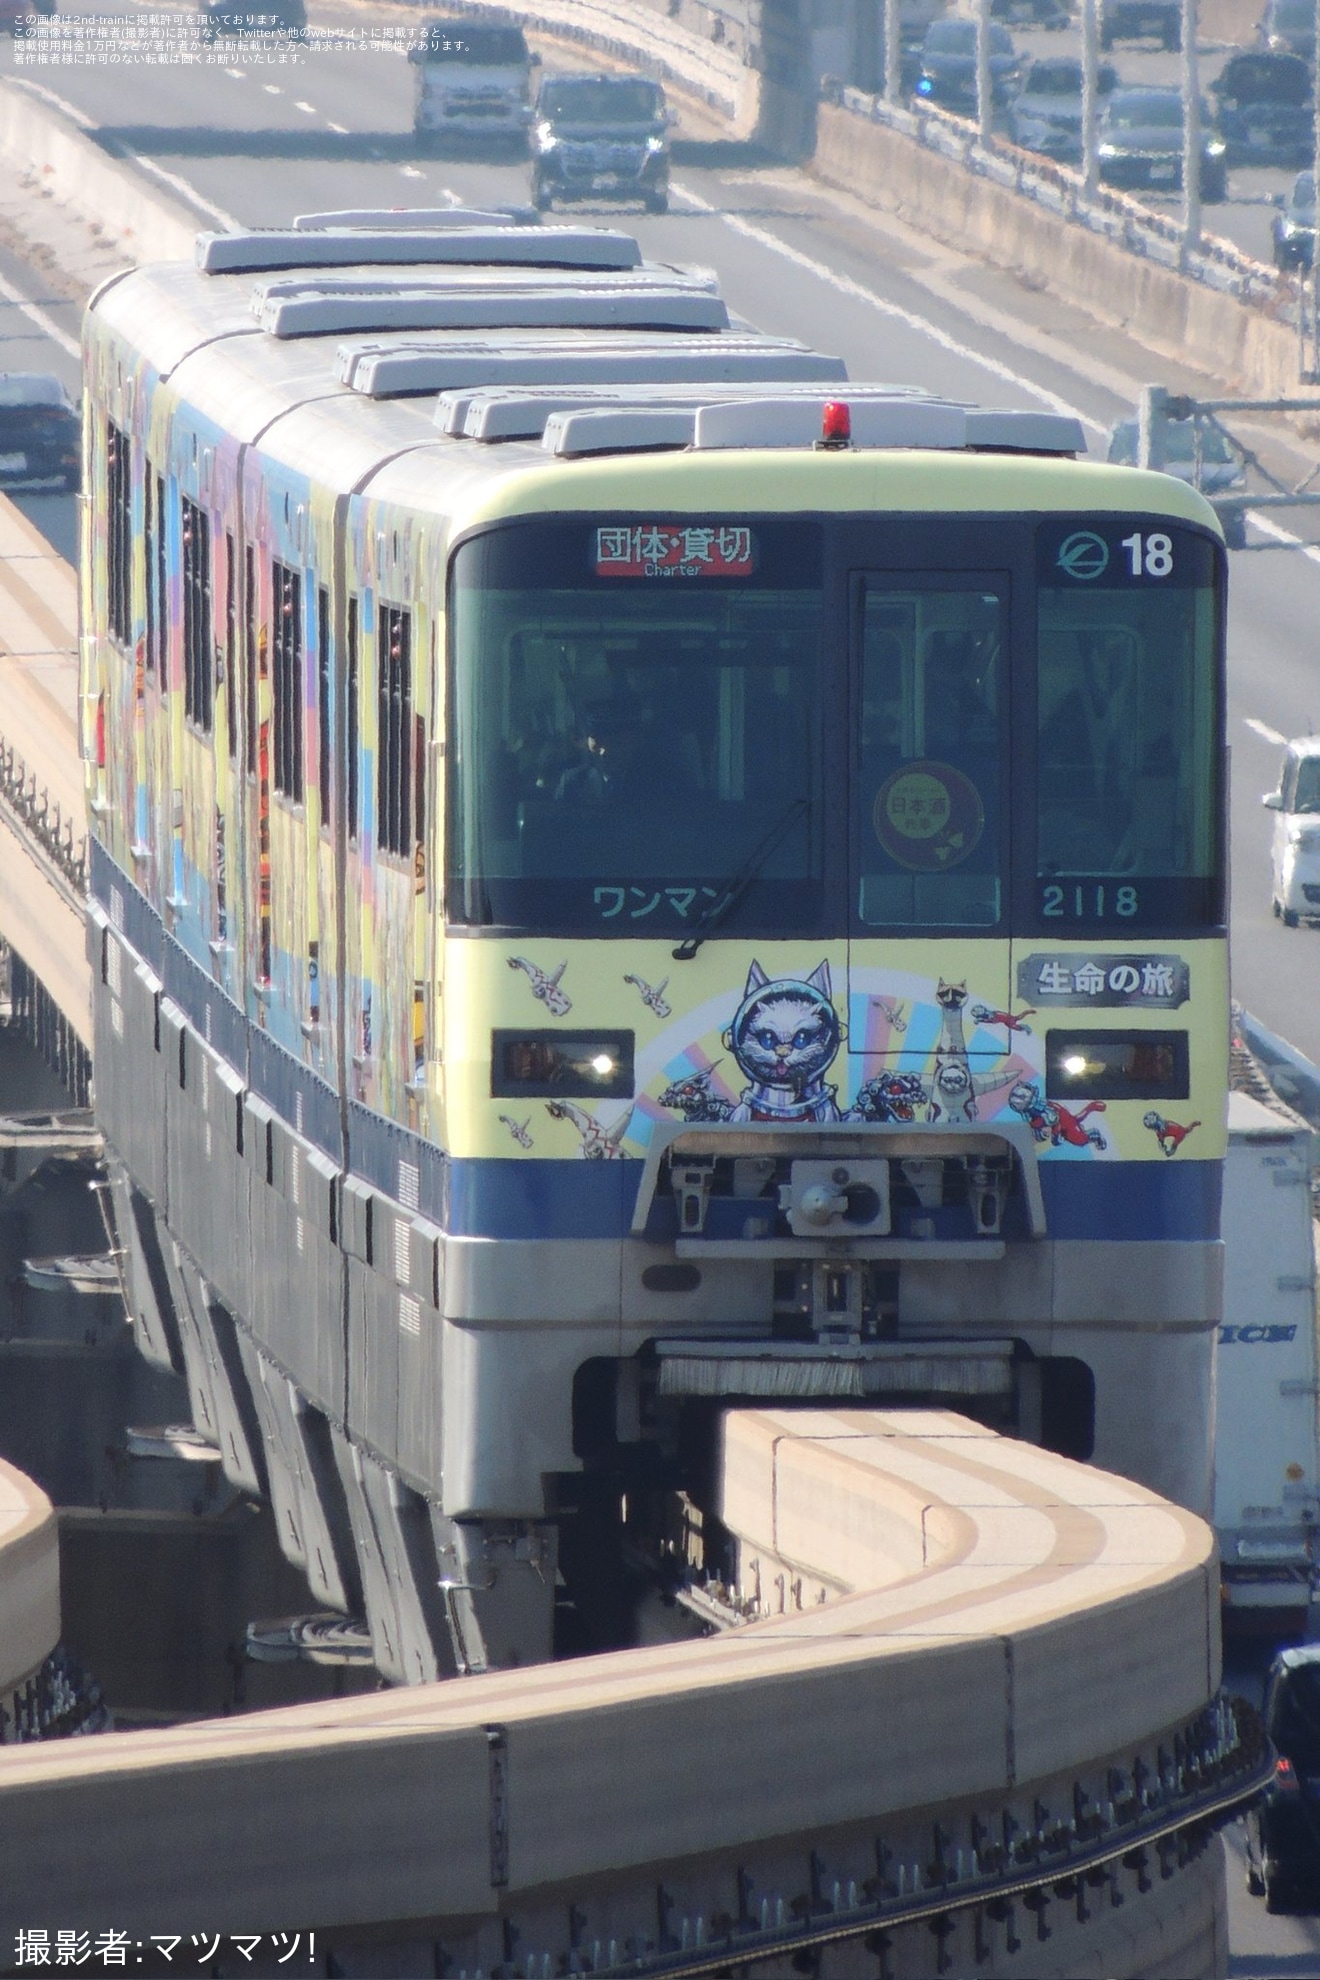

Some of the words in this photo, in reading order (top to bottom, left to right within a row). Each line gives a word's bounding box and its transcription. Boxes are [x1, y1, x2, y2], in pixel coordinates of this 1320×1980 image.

[644, 563, 703, 578] Charter
[1121, 532, 1174, 576] 18
[593, 886, 733, 918] ワンマン
[1042, 884, 1139, 917] 2118
[1036, 961, 1175, 997] 生命の旅
